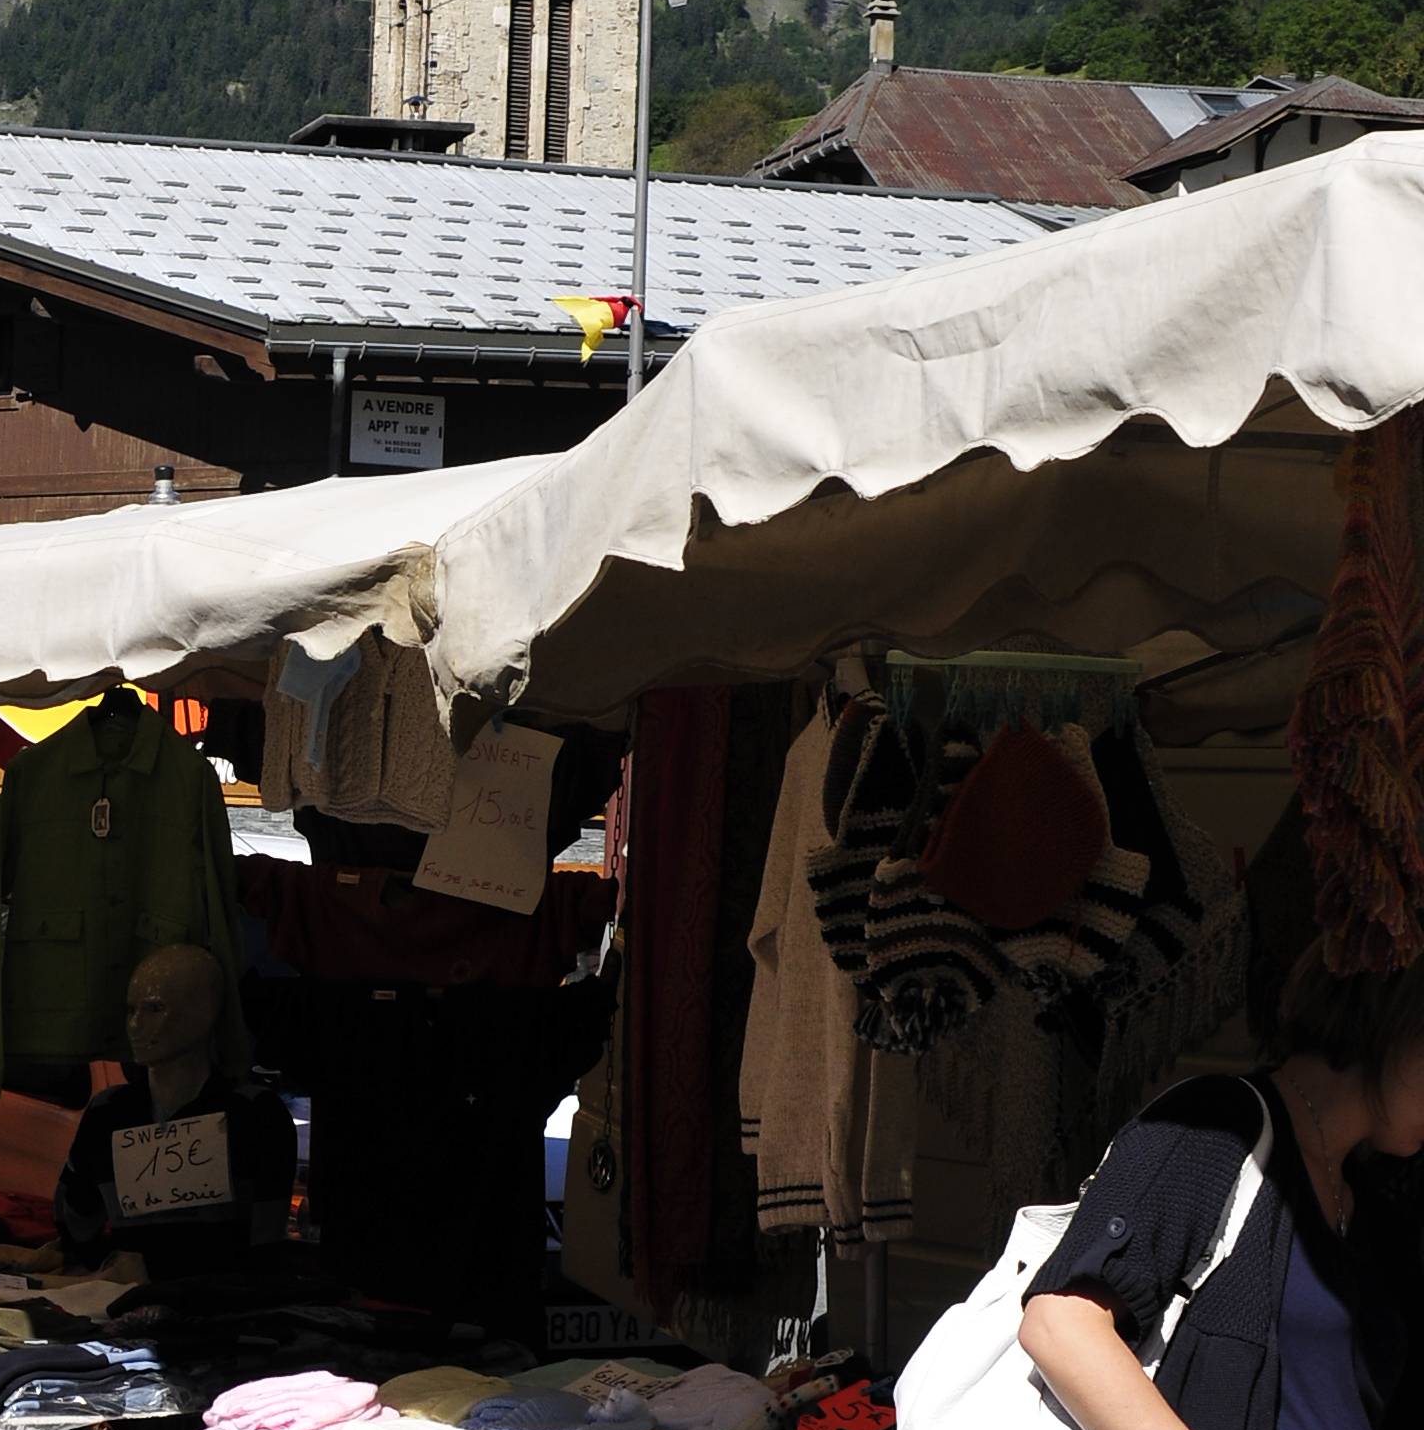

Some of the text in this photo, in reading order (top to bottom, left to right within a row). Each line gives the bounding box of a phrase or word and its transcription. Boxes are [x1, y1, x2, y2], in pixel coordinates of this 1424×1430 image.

[362, 399, 435, 416] A VENDRE
[367, 420, 400, 434] APPT
[122, 1120, 201, 1149] SWEAT
[136, 1139, 213, 1182] 15€
